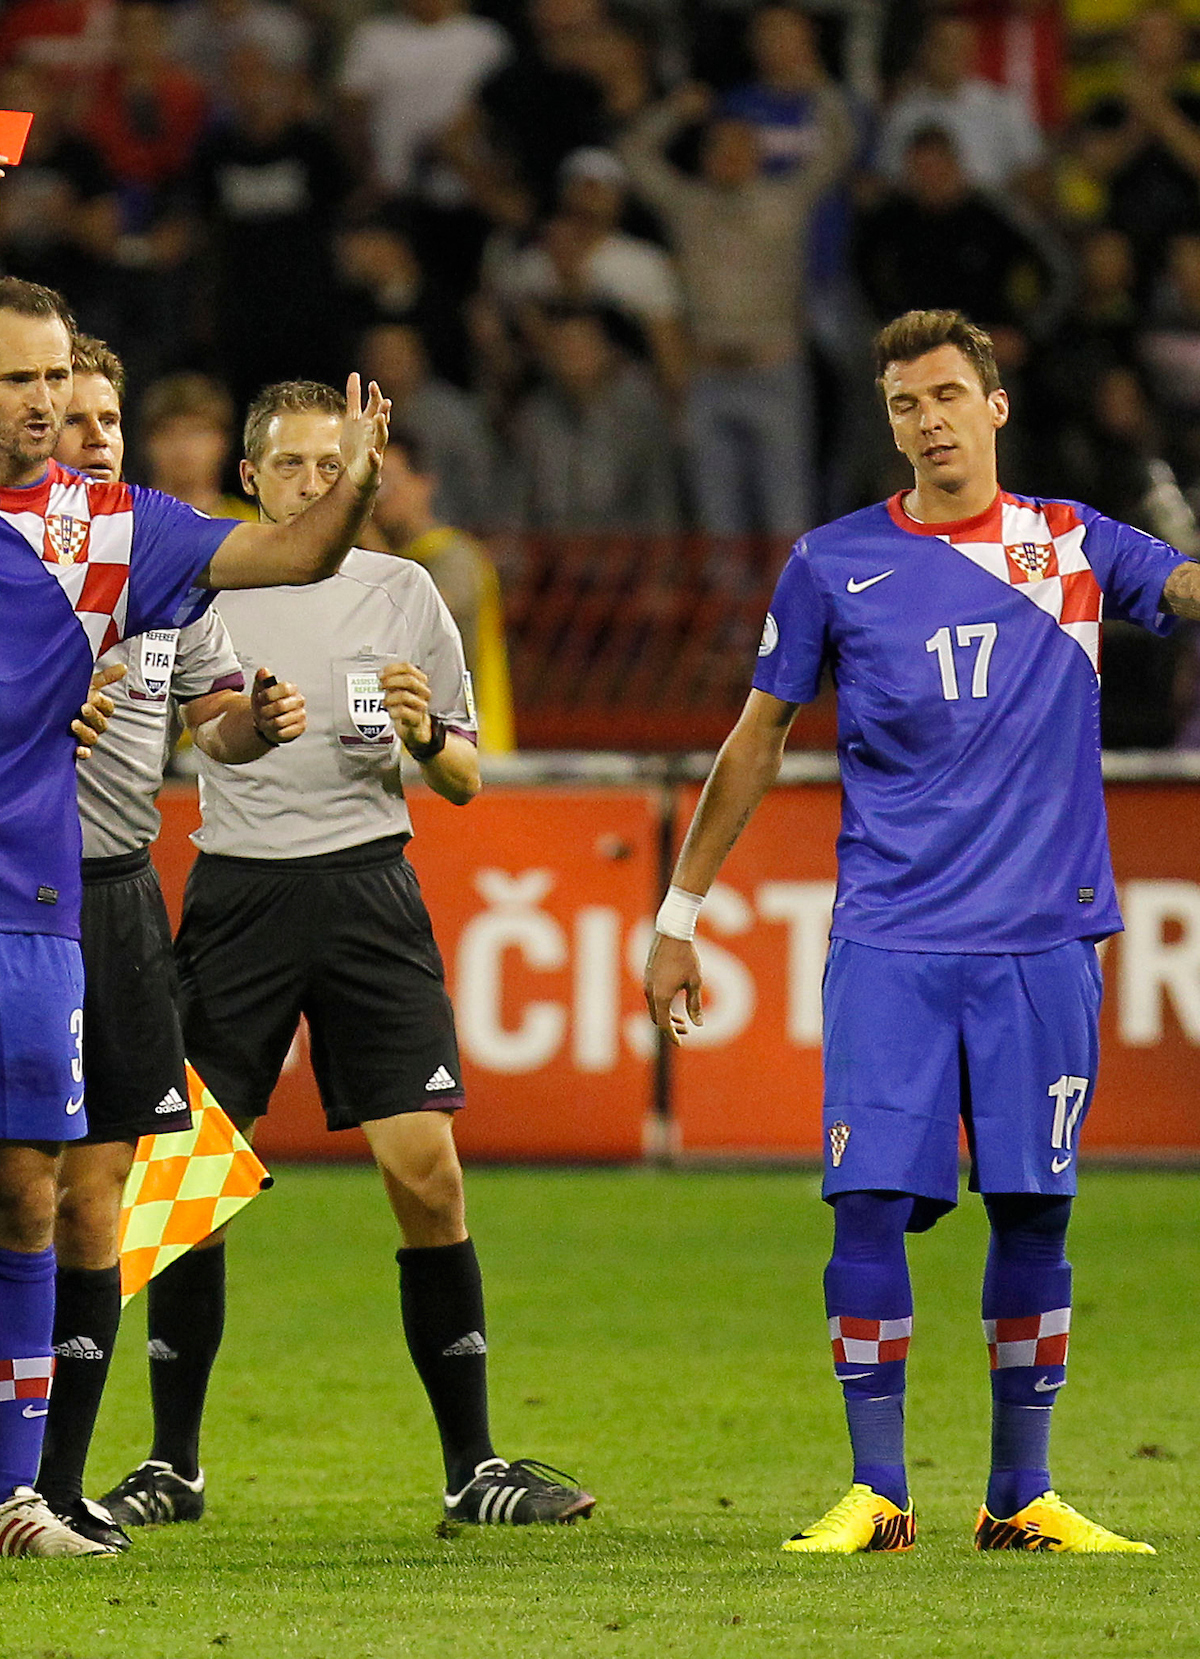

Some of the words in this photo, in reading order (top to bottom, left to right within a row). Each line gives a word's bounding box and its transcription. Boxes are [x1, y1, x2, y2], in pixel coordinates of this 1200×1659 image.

[145, 651, 170, 668] FIFA
[925, 622, 998, 701] 17
[69, 1008, 84, 1083] 3
[1048, 1075, 1089, 1150] 17
